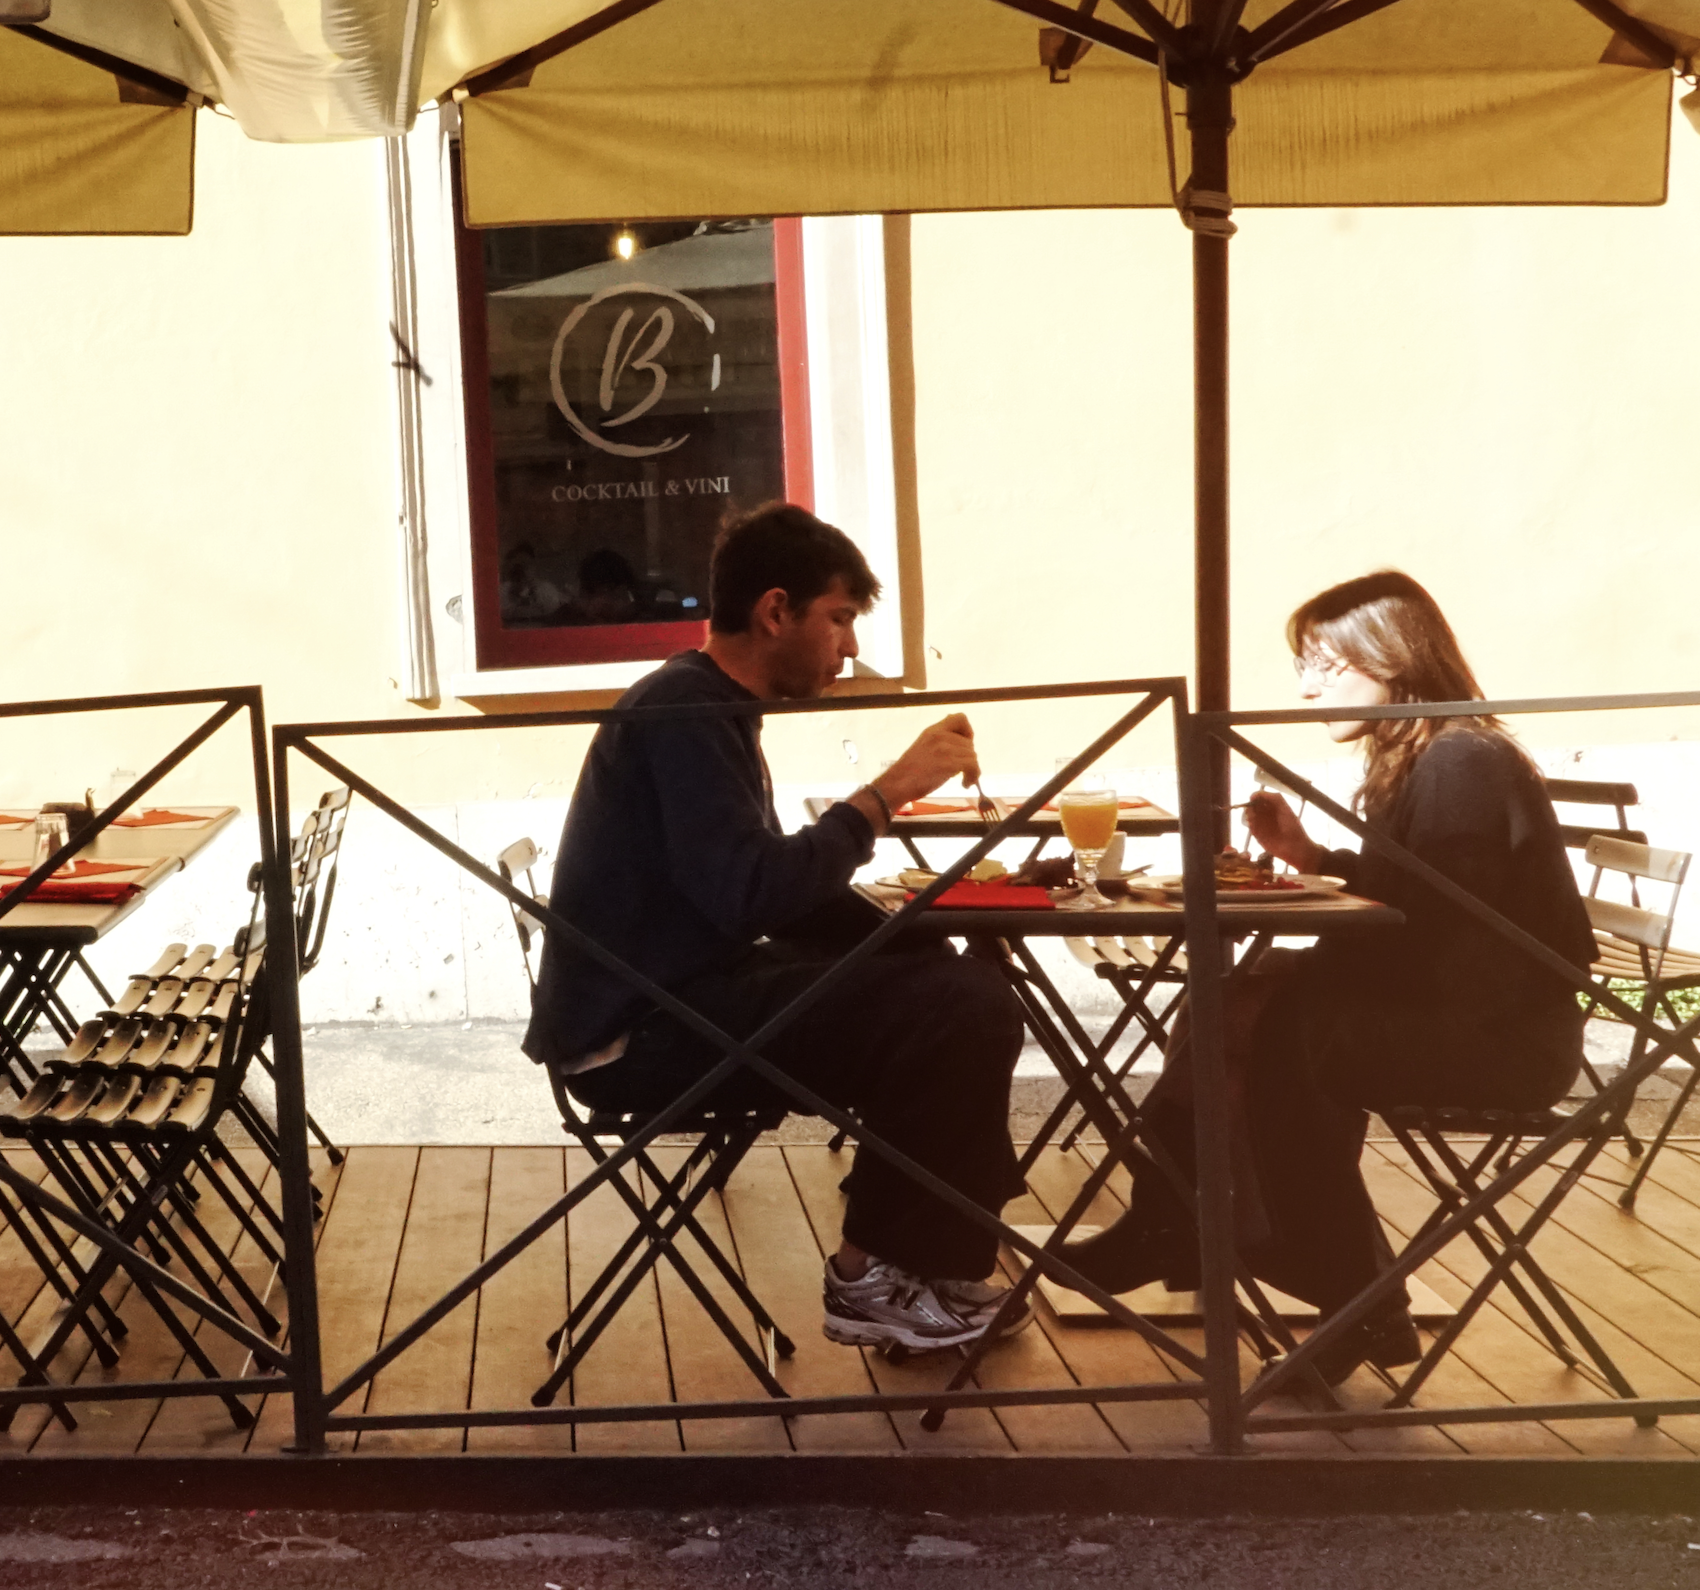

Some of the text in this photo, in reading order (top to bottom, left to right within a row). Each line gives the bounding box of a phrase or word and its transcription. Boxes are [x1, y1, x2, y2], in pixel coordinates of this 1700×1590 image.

[552, 476, 730, 501] COCKTAIL & VINI
